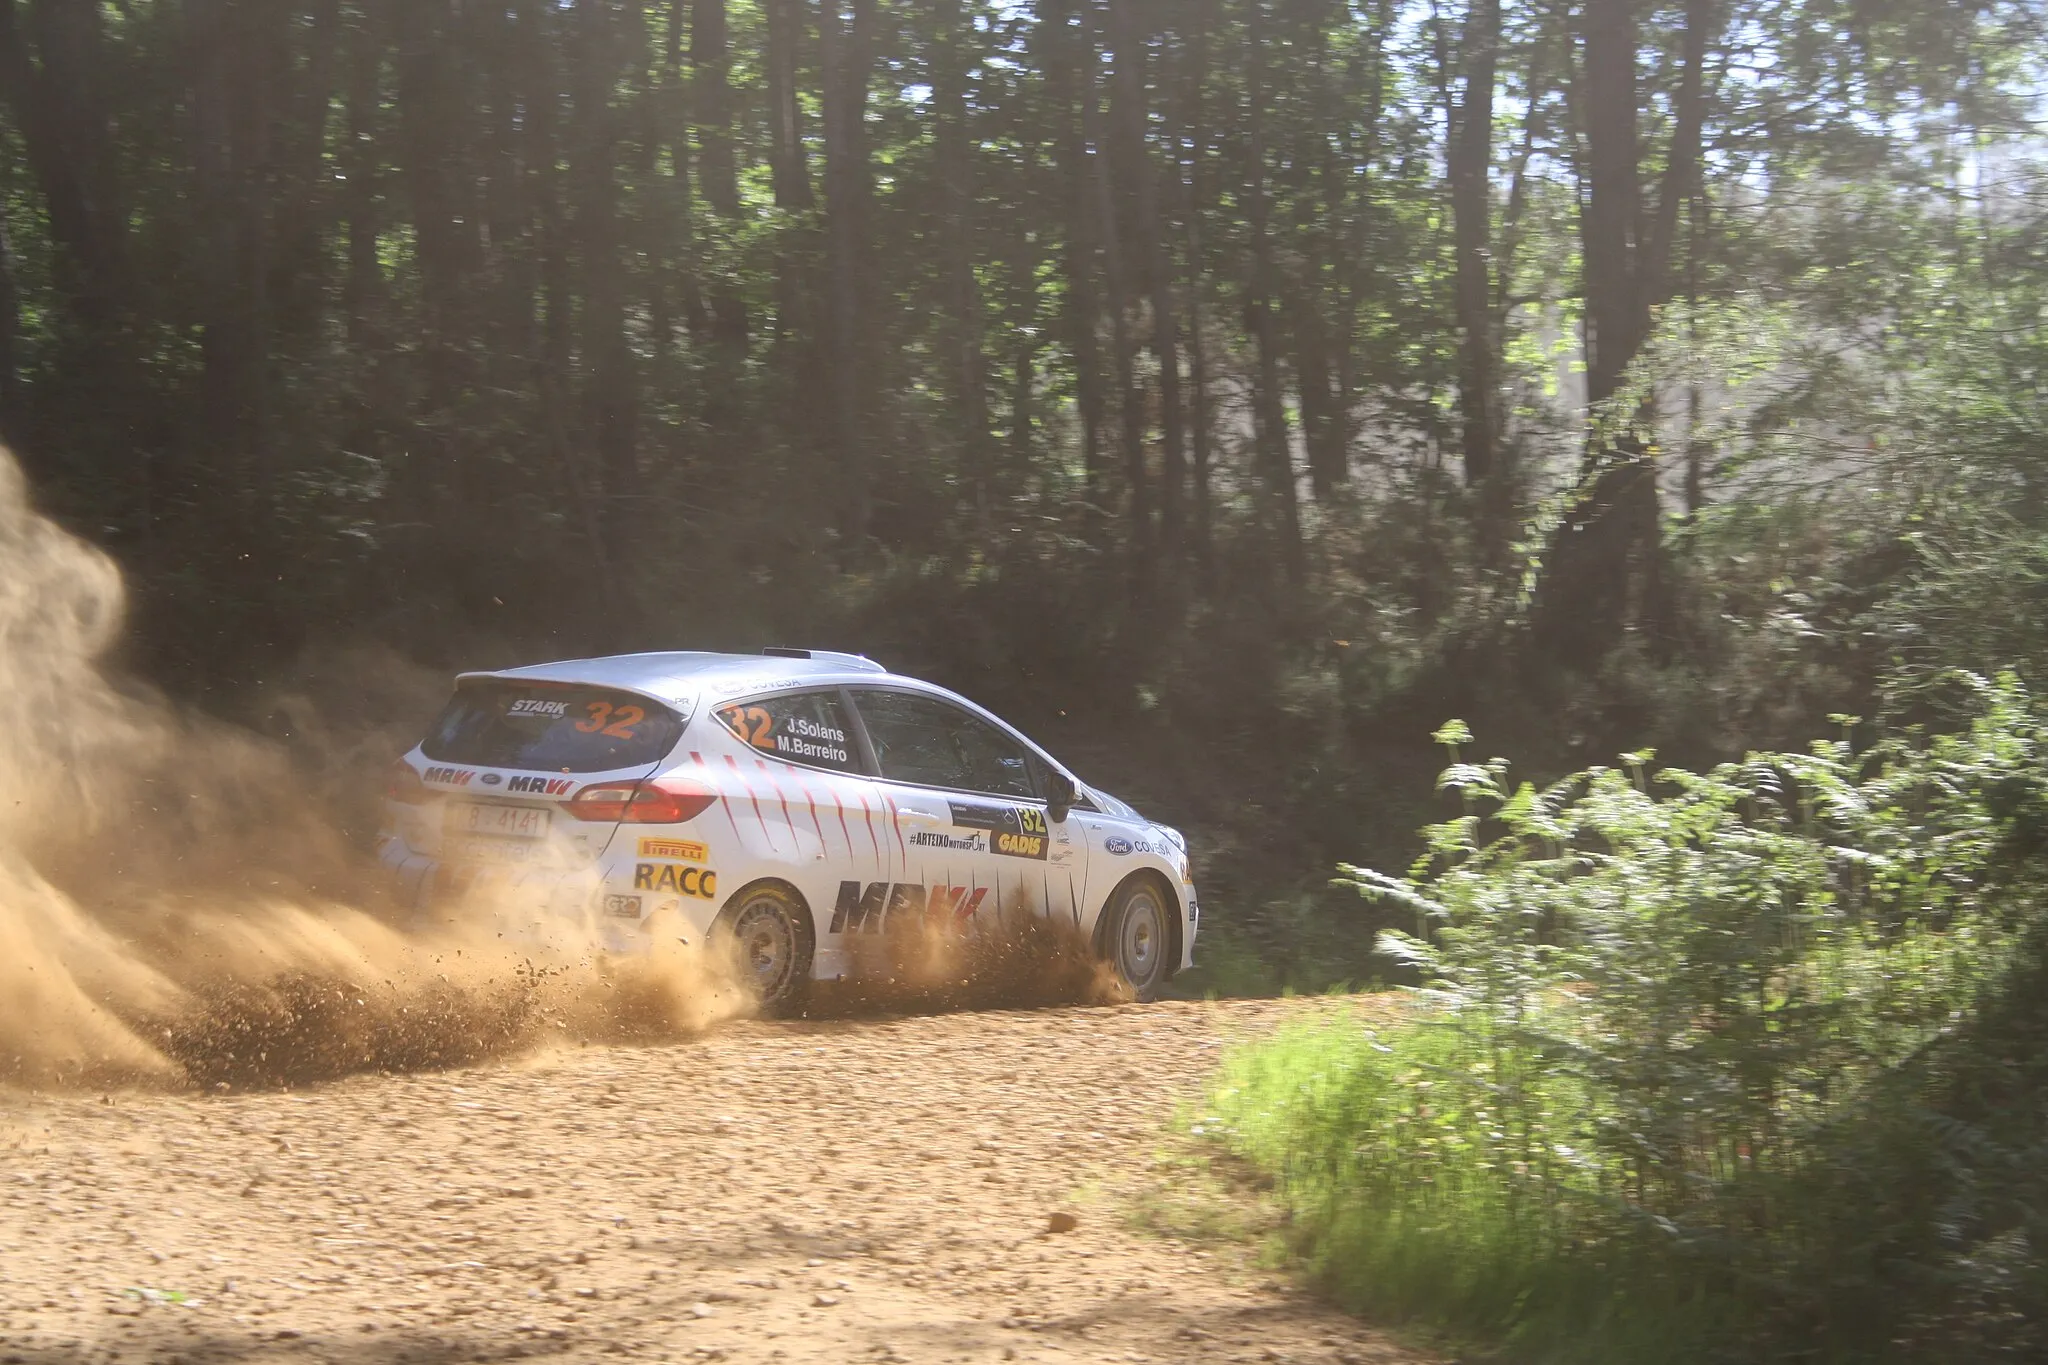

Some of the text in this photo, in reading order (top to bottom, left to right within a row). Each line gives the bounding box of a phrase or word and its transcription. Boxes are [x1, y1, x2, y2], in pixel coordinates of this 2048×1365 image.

[512, 700, 570, 715] STARK
[575, 702, 644, 740] 32
[720, 704, 776, 749] 32
[787, 718, 844, 742] J.Solans
[777, 735, 847, 762] M.Barreiro
[423, 767, 476, 785] MRW
[507, 776, 575, 795] MRW
[1019, 808, 1046, 833] 32
[643, 841, 702, 859] PIRELLI
[998, 833, 1041, 855] GADIS
[1109, 839, 1171, 856] Ford COVESA
[634, 863, 716, 898] RACC
